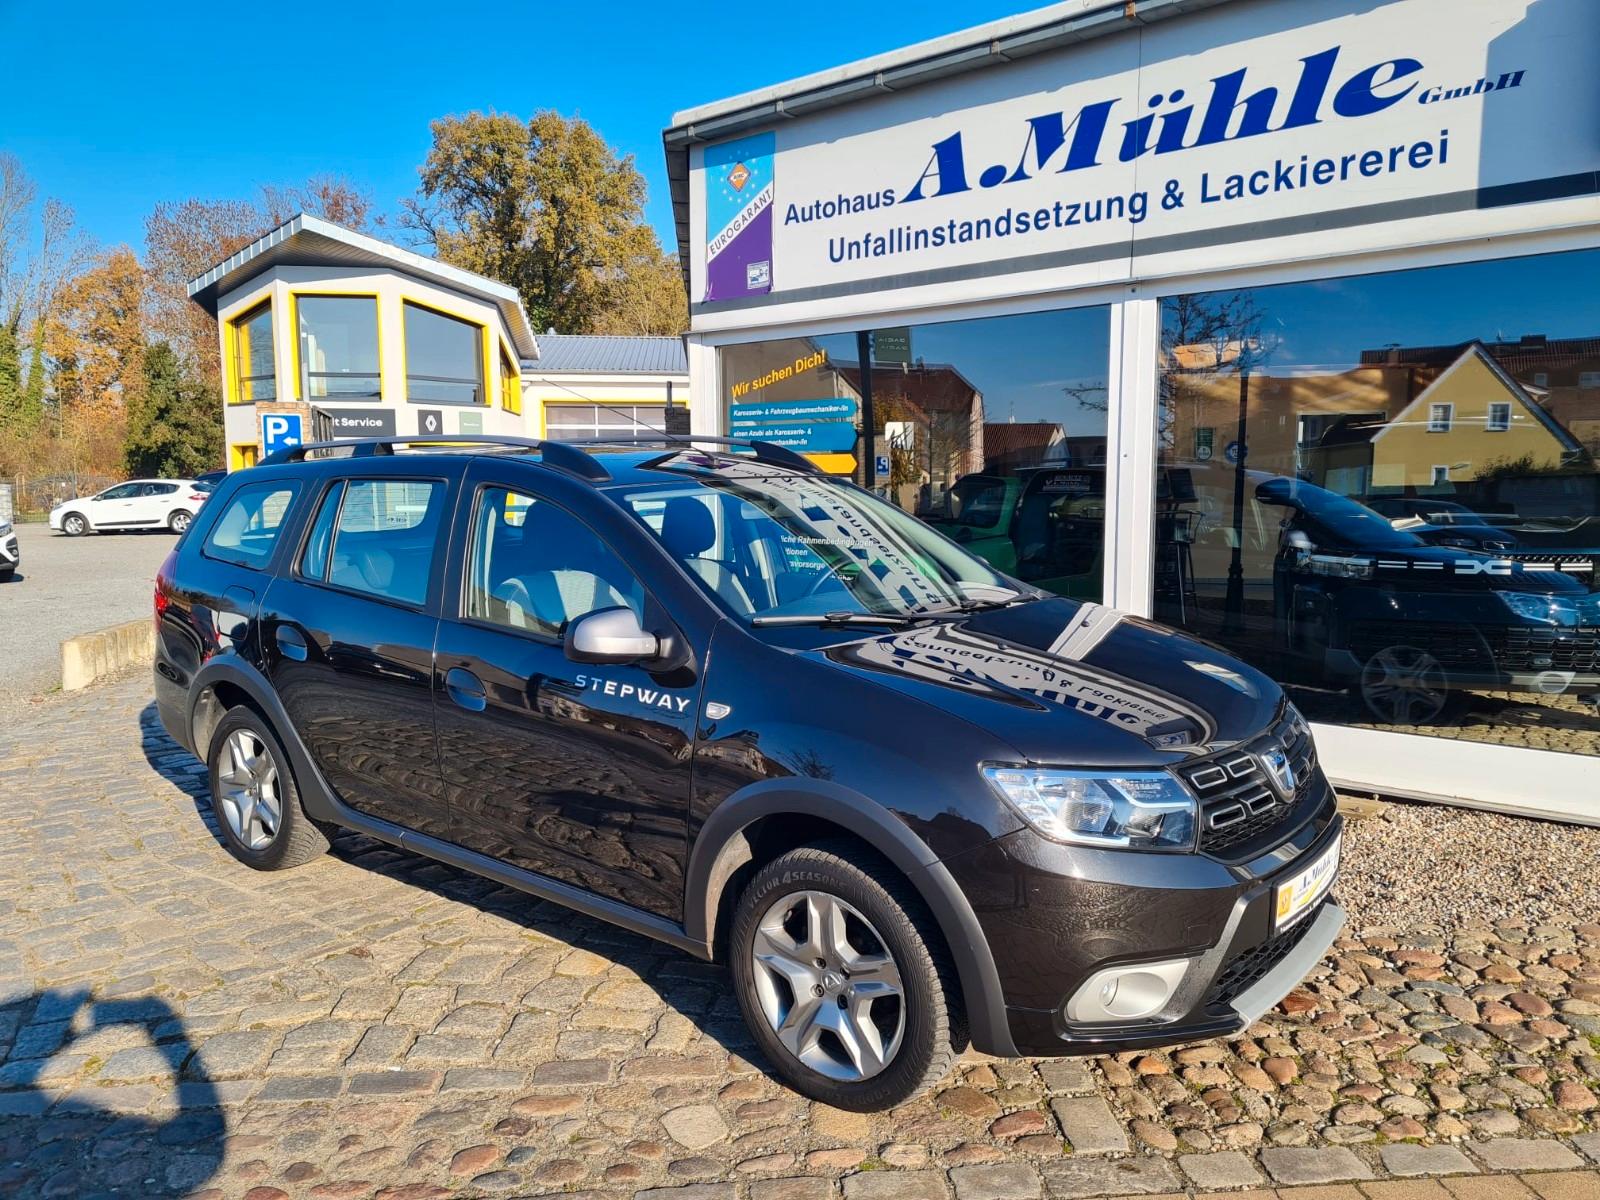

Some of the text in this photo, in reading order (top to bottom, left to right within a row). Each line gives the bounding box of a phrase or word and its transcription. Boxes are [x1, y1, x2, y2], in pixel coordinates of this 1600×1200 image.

[1418, 70, 1526, 105] GmbH
[784, 186, 897, 226] Autohaus
[827, 130, 1450, 263] Unfallinstandsetzung & Lackiererei
[709, 189, 773, 255] EUROGARANT
[731, 349, 825, 397] Wir suchen Dich!
[266, 417, 288, 444] P
[341, 417, 383, 427] Service
[574, 674, 690, 713] STEPWAY
